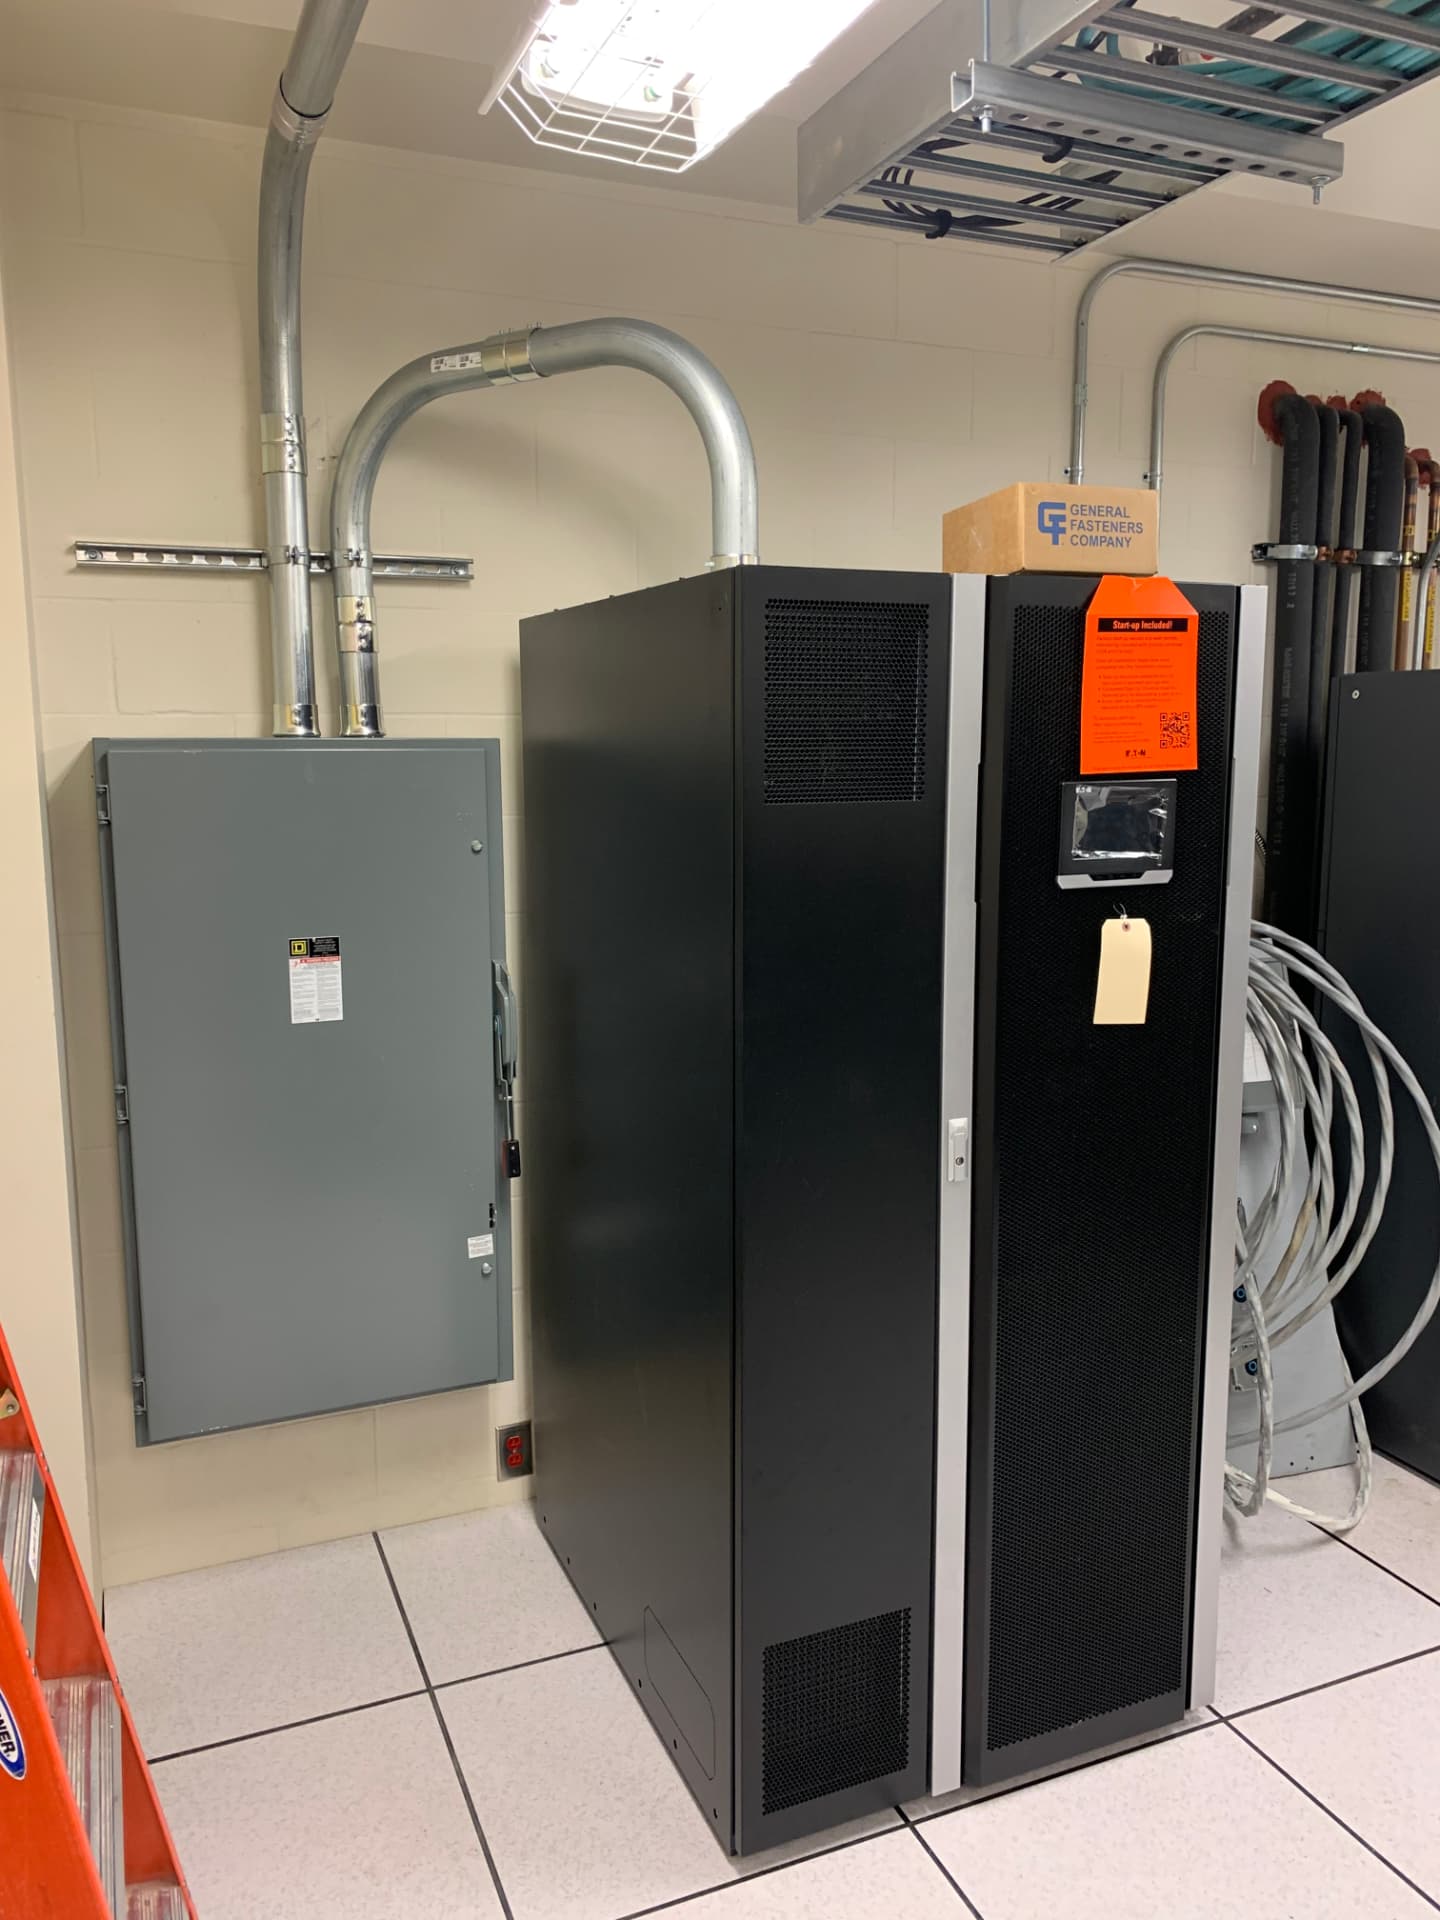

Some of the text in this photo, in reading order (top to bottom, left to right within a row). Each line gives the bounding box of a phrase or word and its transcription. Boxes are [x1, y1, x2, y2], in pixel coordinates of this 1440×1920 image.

[1070, 504, 1131, 518] GENERAL
[1070, 520, 1144, 534] FASTENERS
[1070, 534, 1132, 547] COMPANY
[1113, 620, 1172, 631] Start-up Included!
